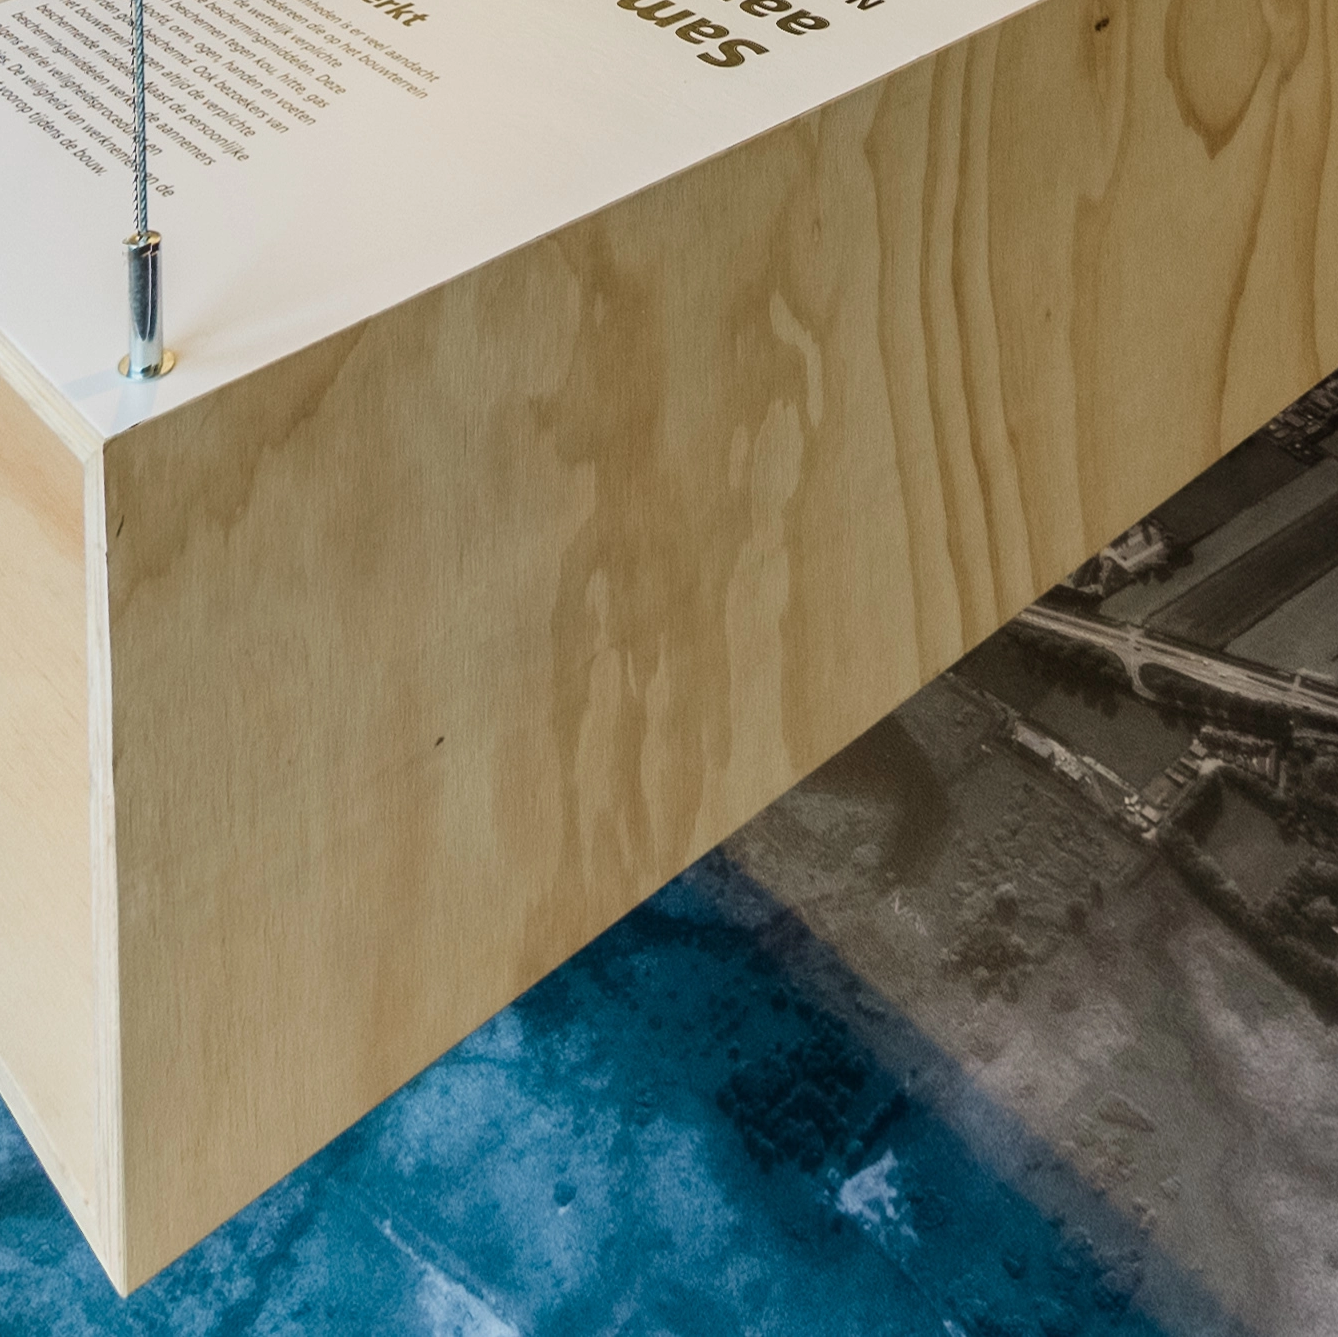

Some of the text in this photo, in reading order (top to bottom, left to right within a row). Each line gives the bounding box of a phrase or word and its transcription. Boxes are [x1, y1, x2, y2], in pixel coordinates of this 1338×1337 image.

[306, 23, 326, 35] die
[323, 34, 341, 45] op
[338, 42, 363, 57] het
[357, 54, 428, 99] bouwterrein
[339, 21, 353, 29] is
[349, 28, 366, 36] er
[362, 35, 392, 51] veel
[384, 50, 440, 83] aandacht
